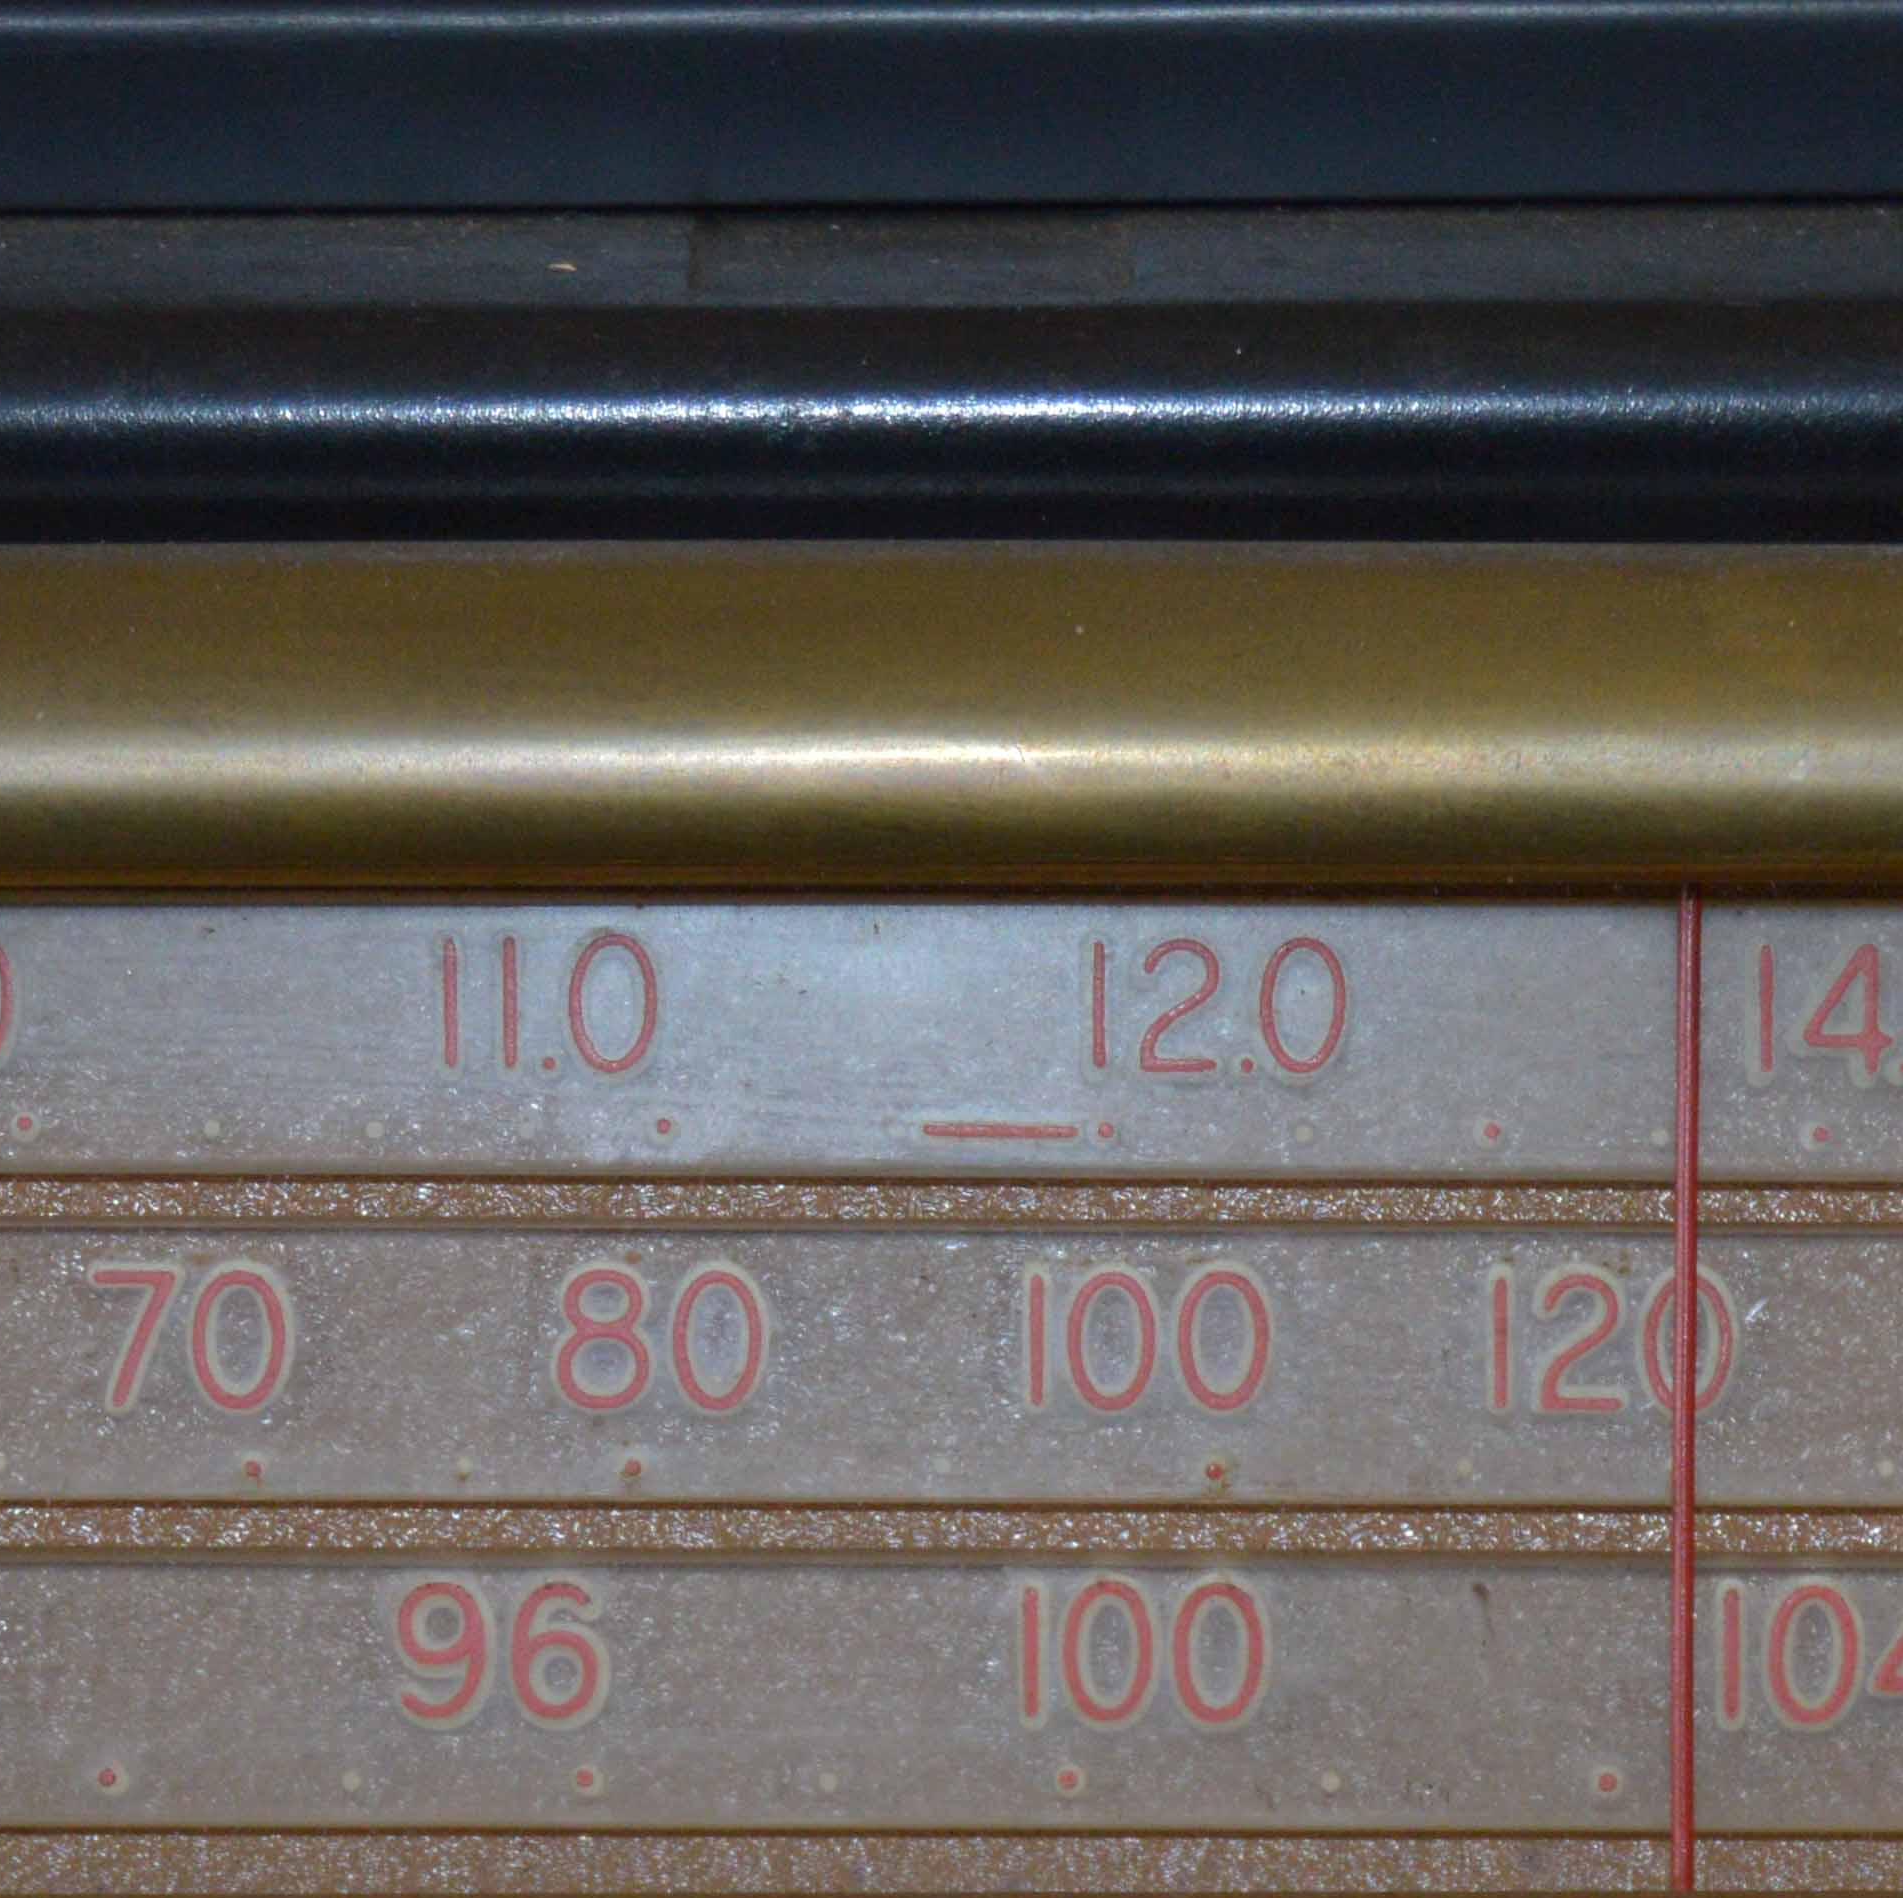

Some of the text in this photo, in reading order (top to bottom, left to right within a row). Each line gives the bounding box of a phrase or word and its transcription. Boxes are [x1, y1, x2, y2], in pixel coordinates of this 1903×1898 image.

[439, 929, 661, 1077] 11.0
[1089, 934, 1350, 1077] 12.0
[89, 1266, 289, 1414] 70
[554, 1266, 766, 1414] 80
[1026, 1267, 1273, 1415] 100
[1490, 1270, 1736, 1416] 120
[394, 1579, 602, 1722] 96
[1019, 1576, 1268, 1727] 100
